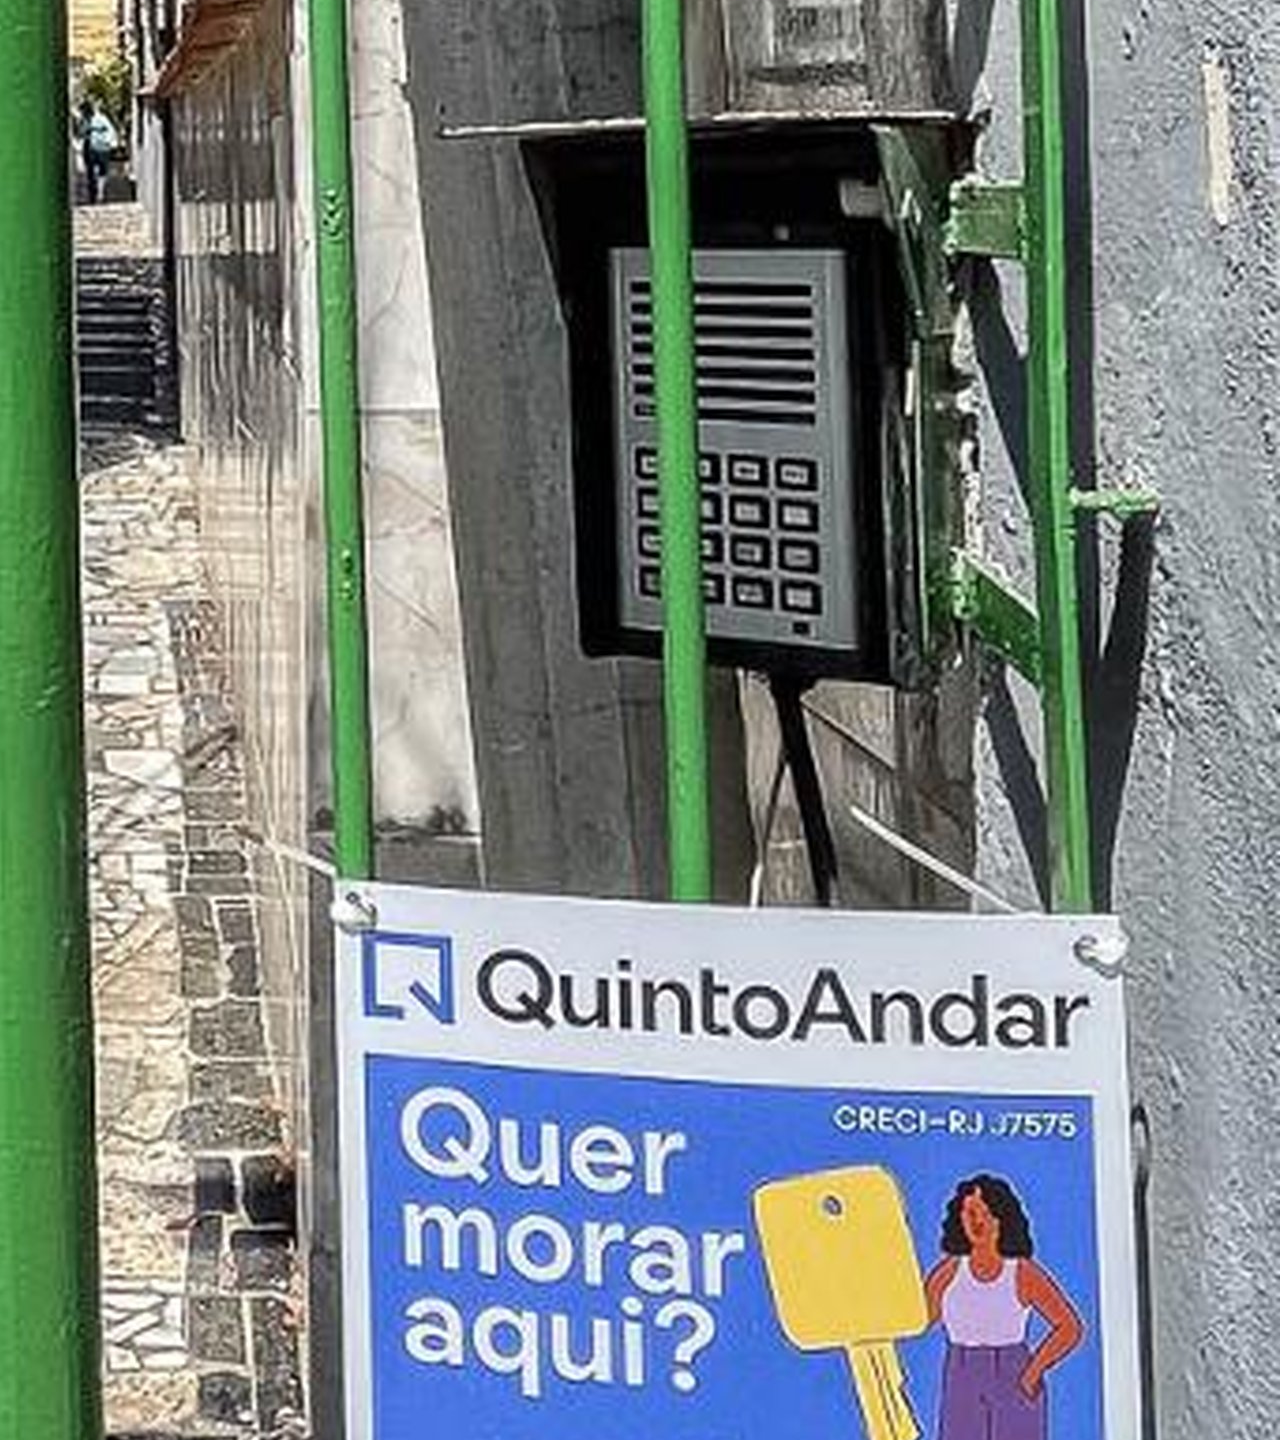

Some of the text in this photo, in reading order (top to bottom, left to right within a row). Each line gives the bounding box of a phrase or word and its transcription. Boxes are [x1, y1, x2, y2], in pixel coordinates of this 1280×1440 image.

[474, 946, 1092, 1050] QuintoAndar
[398, 1085, 688, 1195] Quer
[402, 1199, 746, 1299] morar
[402, 1291, 718, 1400] aqui?
